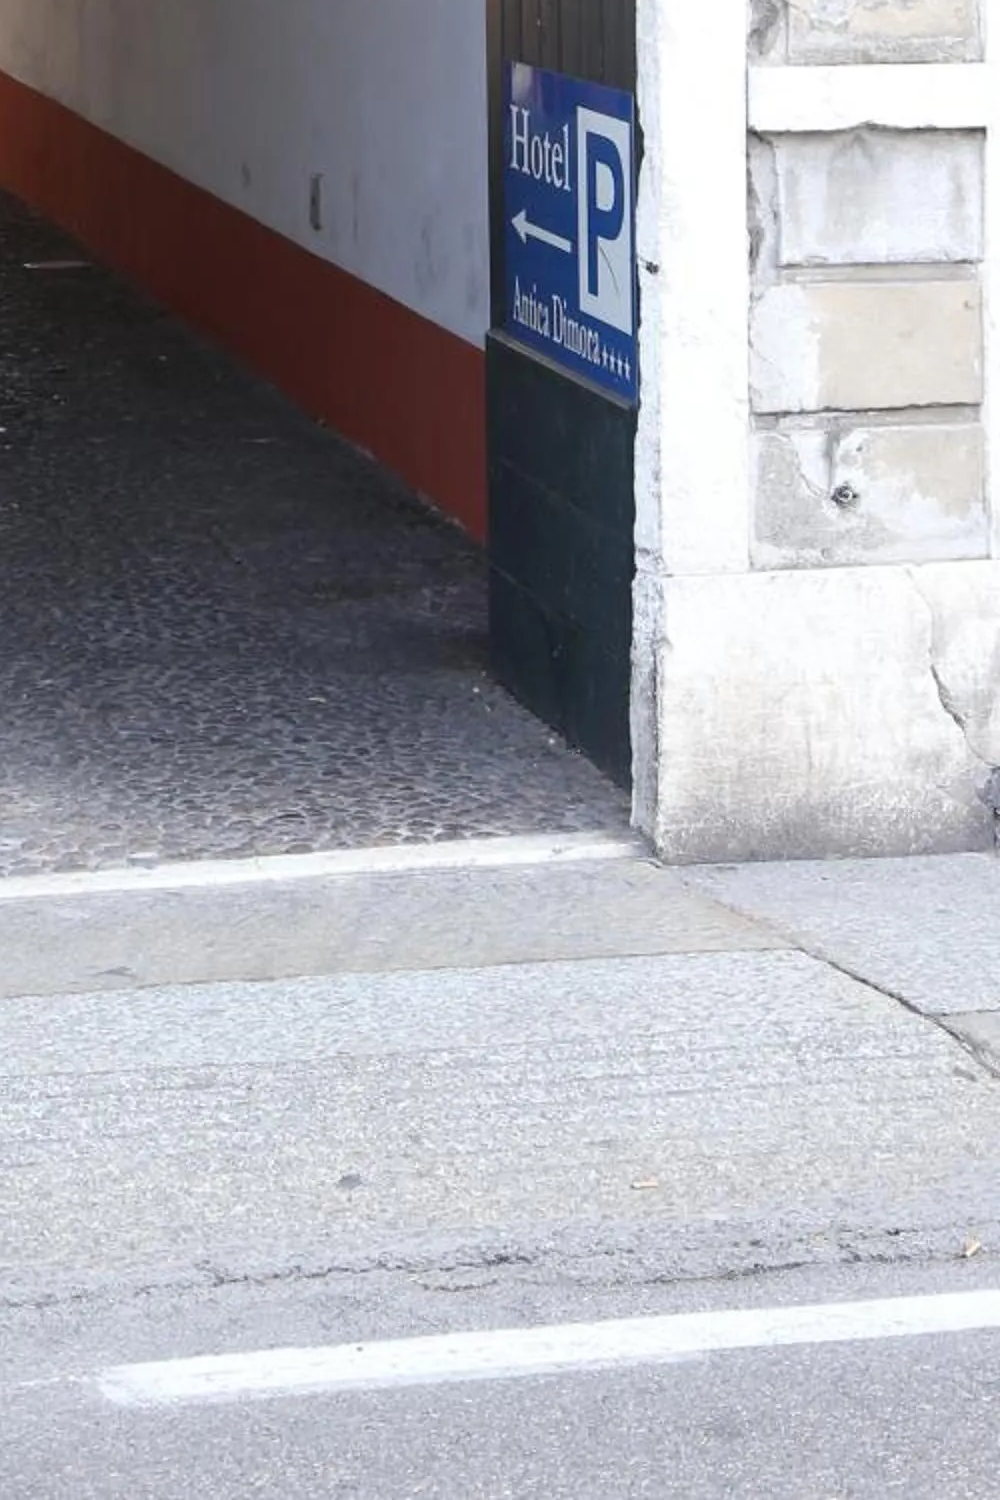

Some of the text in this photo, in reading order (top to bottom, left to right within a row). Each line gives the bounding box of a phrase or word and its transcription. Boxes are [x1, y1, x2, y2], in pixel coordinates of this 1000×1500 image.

[510, 104, 572, 192] Hotel
[586, 131, 625, 297] P
[513, 275, 600, 364] Antica Dimora
